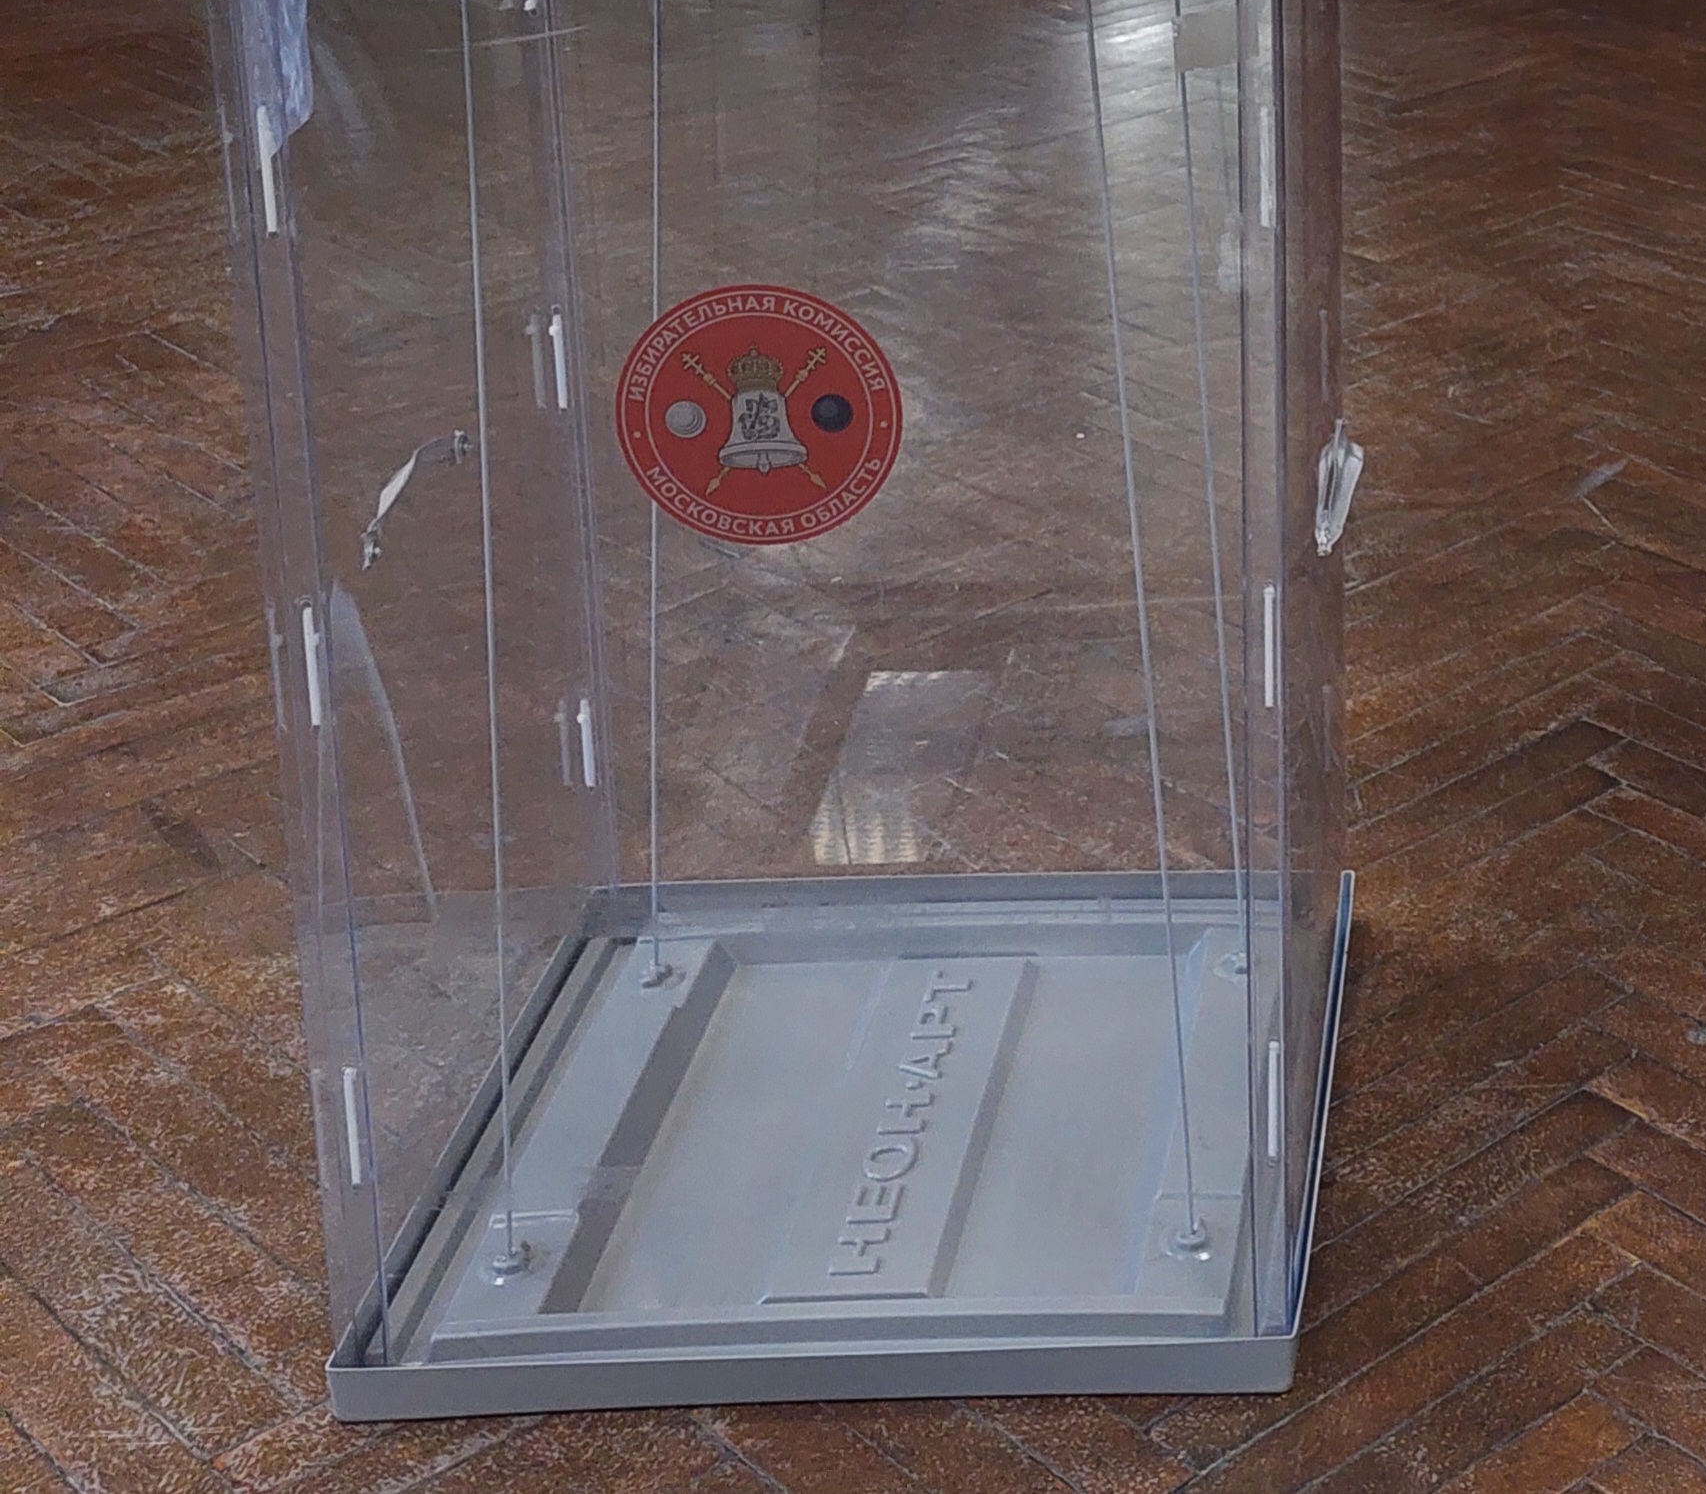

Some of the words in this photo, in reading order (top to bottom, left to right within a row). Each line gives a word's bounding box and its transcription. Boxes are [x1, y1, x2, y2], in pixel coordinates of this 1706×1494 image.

[628, 295, 776, 403] ИЗБИРАТЕЛЬНАЯ
[783, 299, 886, 391] КОМИССИЯ
[646, 464, 795, 536] МОСКОВСКАЯ
[800, 456, 883, 528] ОБЛАСТЬ
